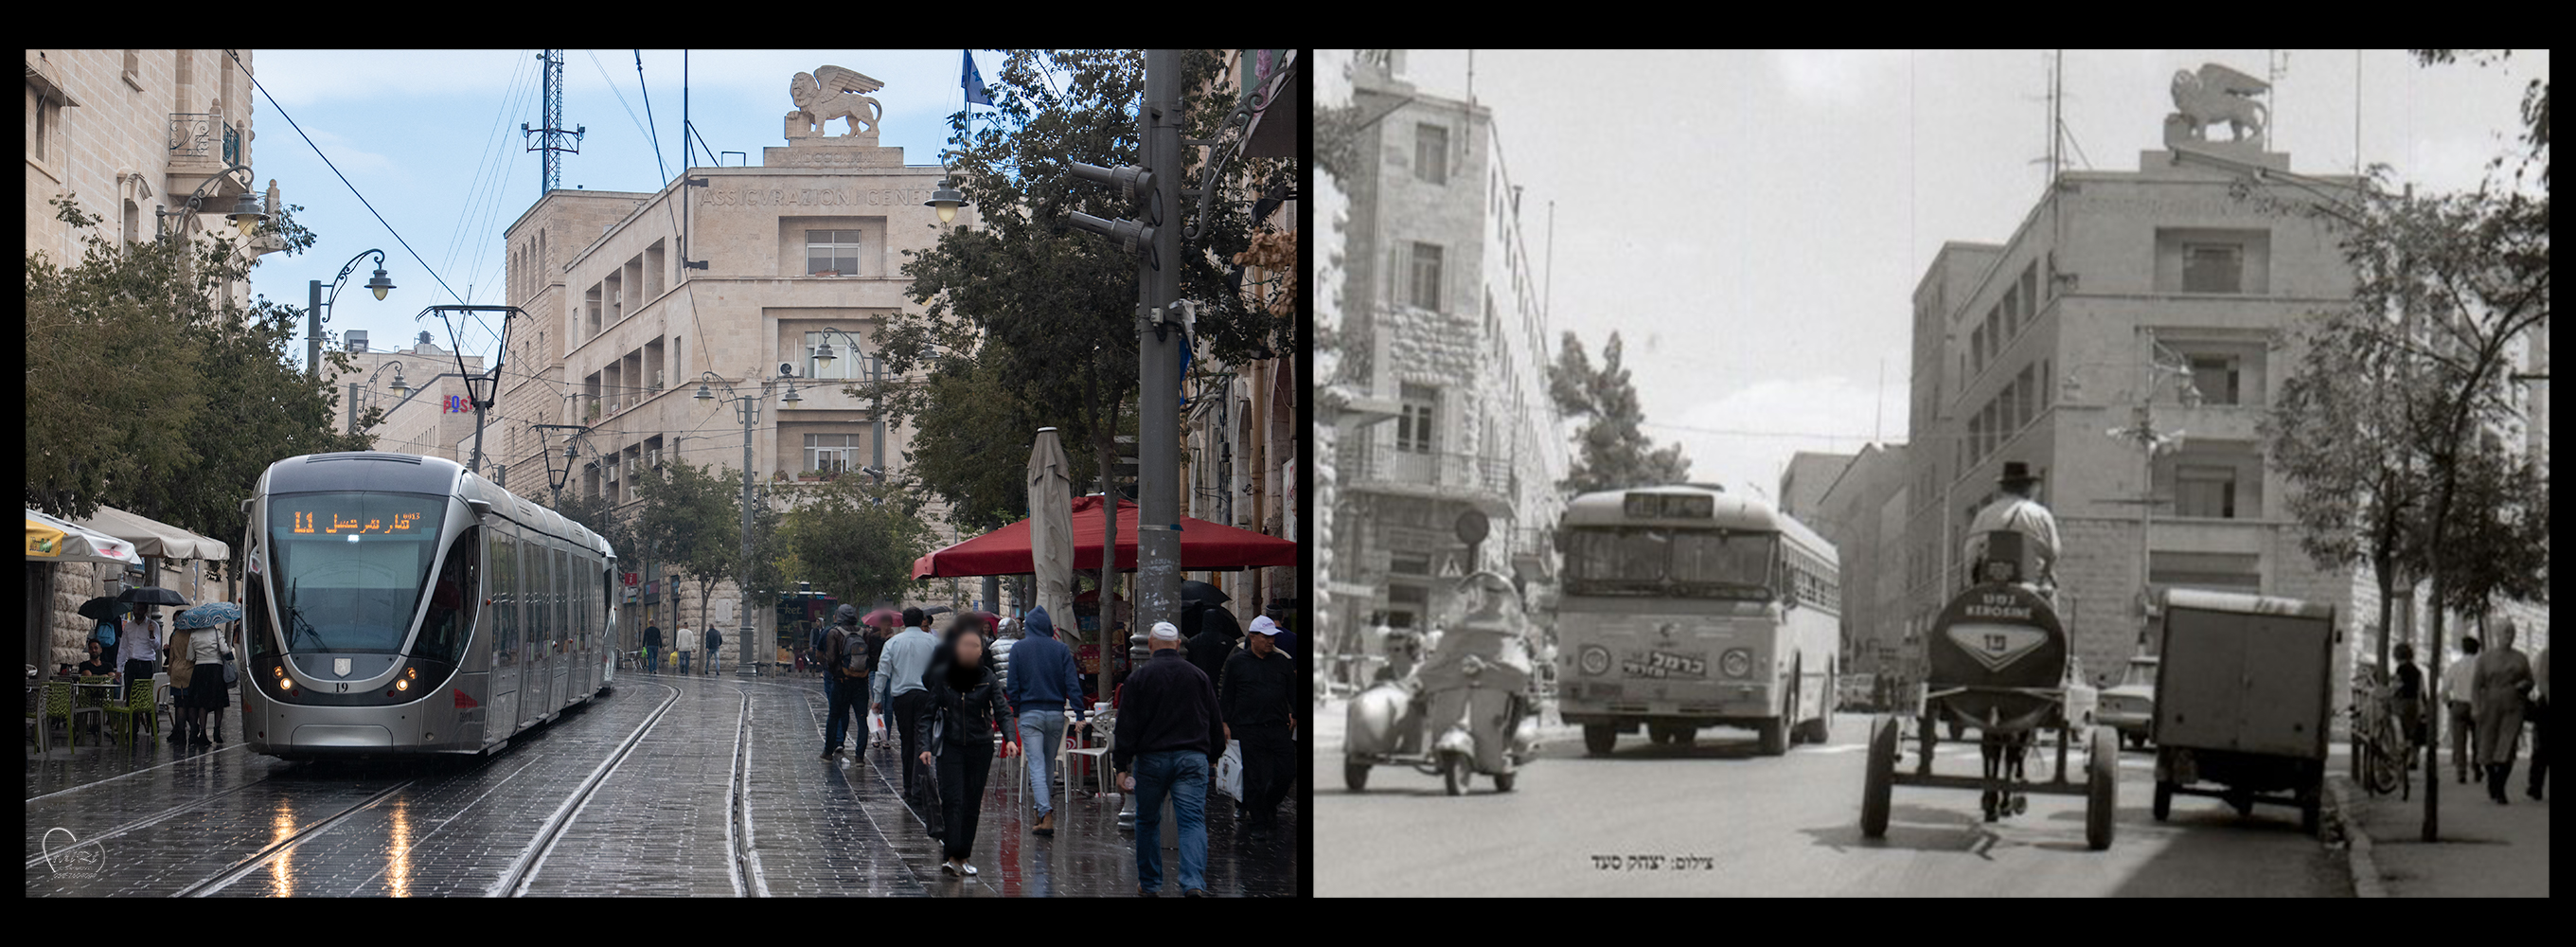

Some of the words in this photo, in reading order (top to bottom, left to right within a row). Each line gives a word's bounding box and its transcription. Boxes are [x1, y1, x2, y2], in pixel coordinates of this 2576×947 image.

[700, 188, 859, 206] ASSICVRAZIONI
[443, 395, 472, 414] POST
[1652, 652, 1705, 673] כרמל
[334, 682, 348, 693] 19
